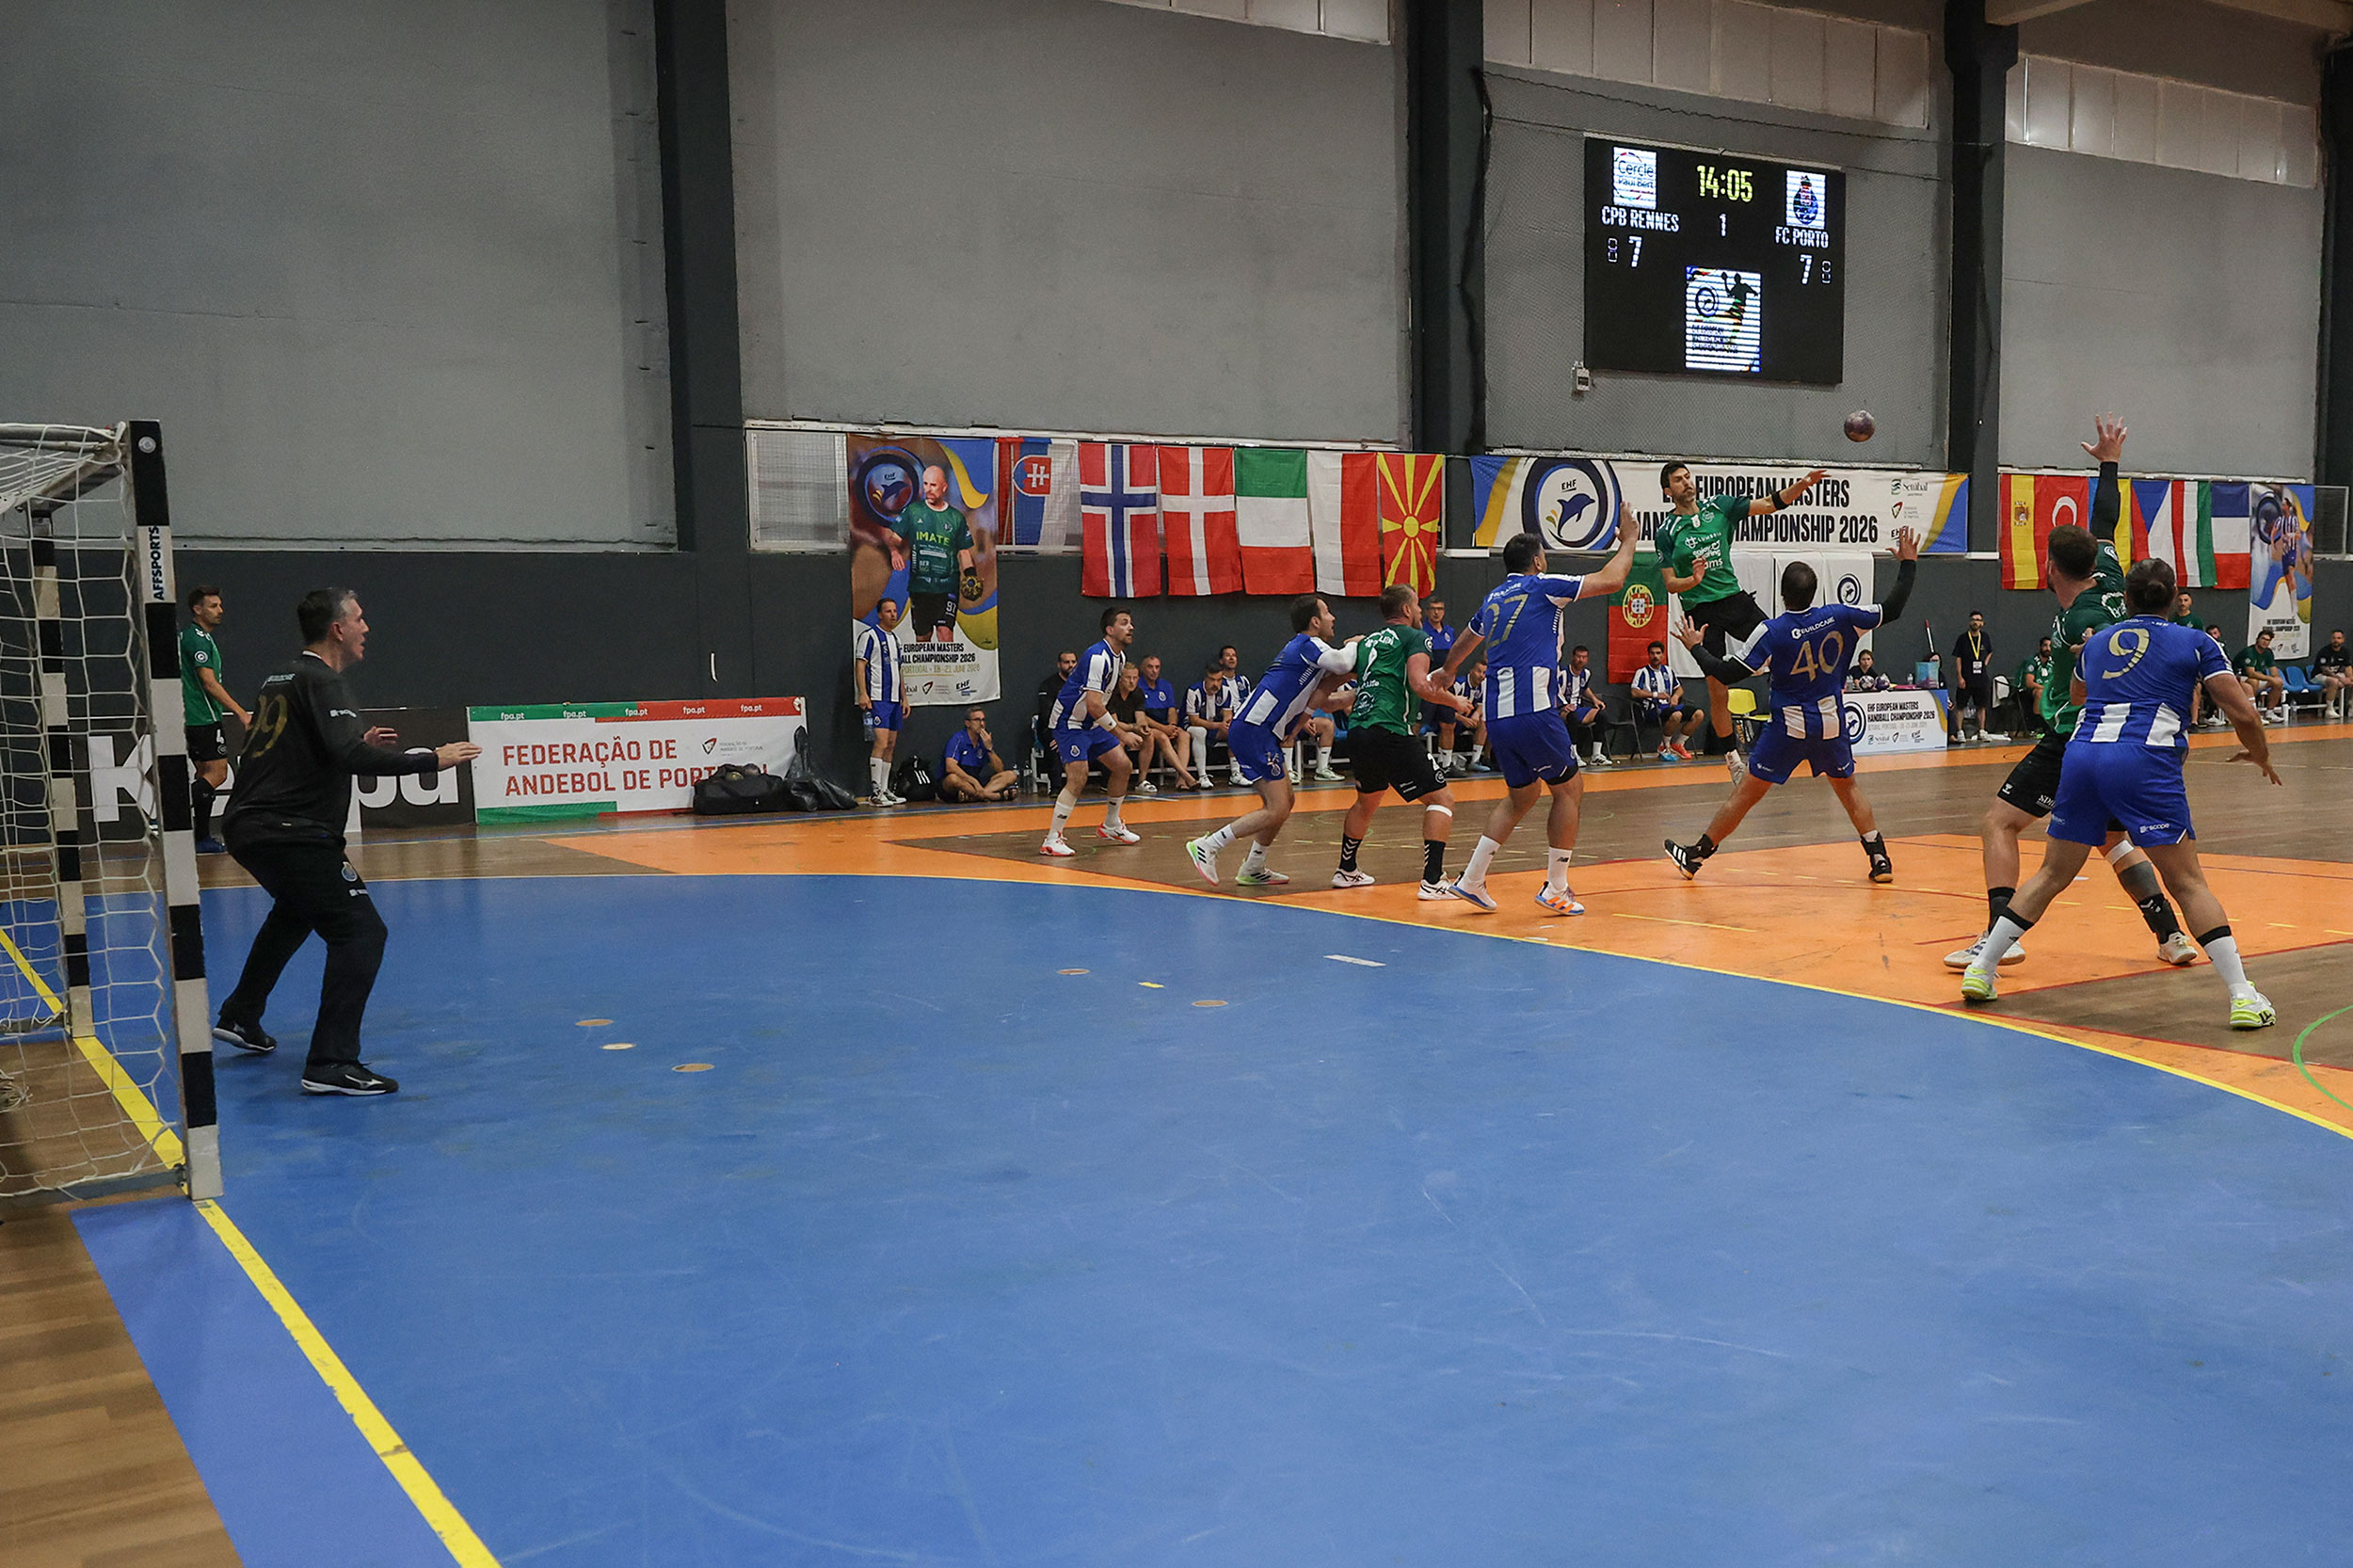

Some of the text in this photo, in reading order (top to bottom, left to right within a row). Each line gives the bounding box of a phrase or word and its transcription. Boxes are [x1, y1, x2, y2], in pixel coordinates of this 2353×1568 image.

[1697, 165, 1753, 202] 14:05
[1601, 205, 1679, 232] CPB RENNES
[1719, 213, 1727, 236] 1
[1627, 235, 1642, 267] 7
[1775, 226, 1829, 248] FC PORTO
[1800, 253, 1813, 284] 7
[1561, 479, 1577, 492] EHF
[1696, 475, 1776, 502] EUROPEAN
[1736, 513, 1879, 543] AMPIONSHIP 2026
[148, 525, 165, 600] AFFSPORTS
[1484, 593, 1529, 649] 27
[904, 643, 965, 653] EUROPEAN MASTERS
[912, 653, 959, 664] CHAMPIONSHIP
[960, 652, 976, 663] 2026
[1790, 631, 1844, 681] 40
[2101, 628, 2151, 680] 9
[501, 704, 763, 721] fpa.pt fpa.pt fpa.pt fpa.pt fpa.pt
[503, 735, 678, 768] FEDERAÇÃO DE
[88, 733, 459, 833] Kpa
[505, 771, 616, 796] ANDEBOL
[623, 769, 651, 791] DE
